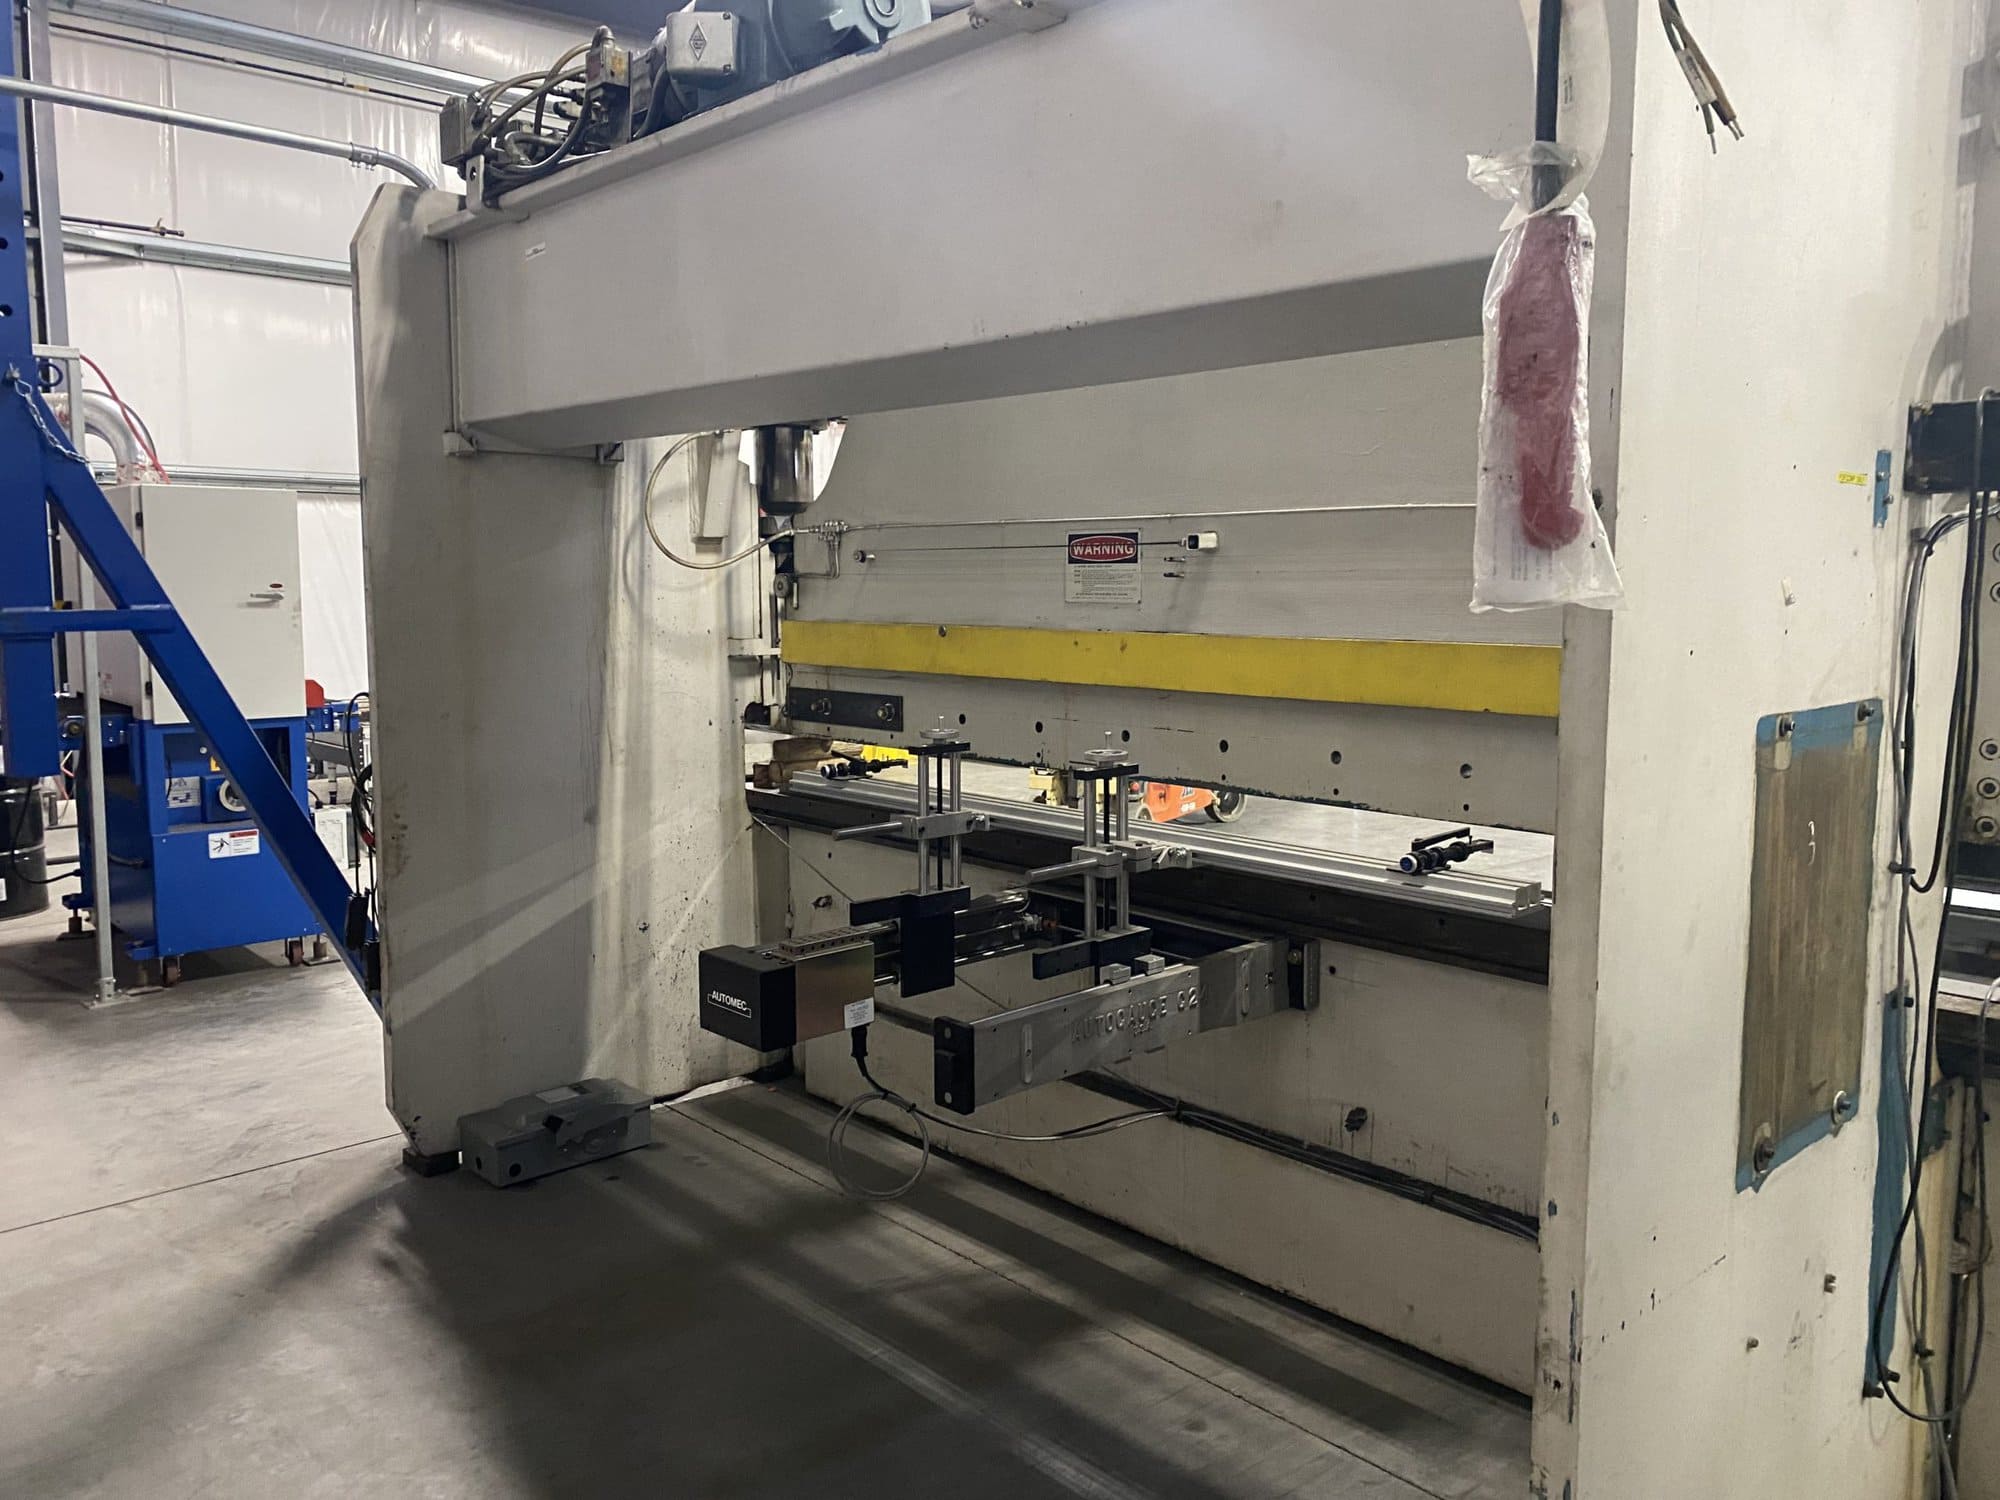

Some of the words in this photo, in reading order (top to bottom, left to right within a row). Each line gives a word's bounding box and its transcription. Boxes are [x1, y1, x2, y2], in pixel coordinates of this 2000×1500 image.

[1073, 541, 1134, 555] WARNING
[712, 990, 747, 1011] AUTOMEC
[1071, 995, 1168, 1044] AUTOGAUGE
